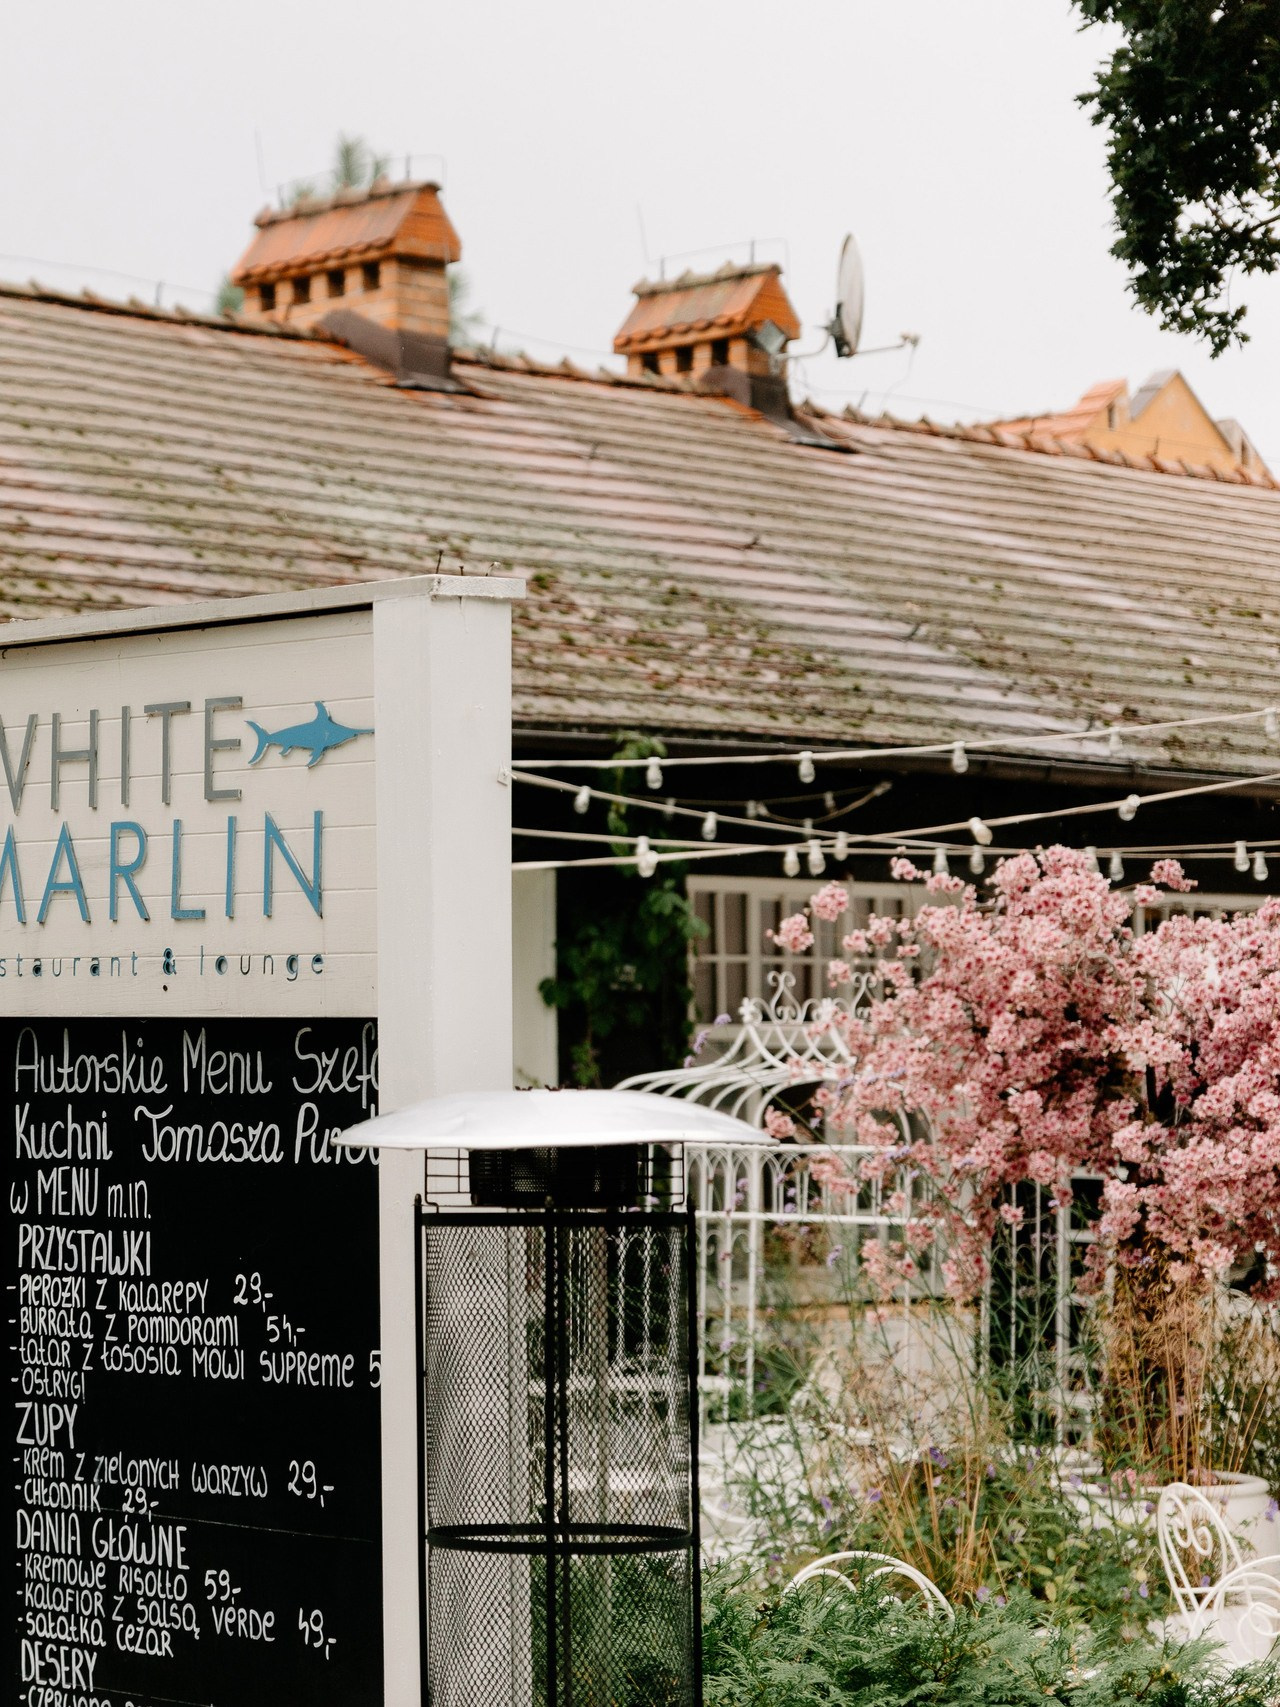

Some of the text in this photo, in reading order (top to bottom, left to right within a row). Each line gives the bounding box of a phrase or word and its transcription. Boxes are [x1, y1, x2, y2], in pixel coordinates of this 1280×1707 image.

[162, 947, 178, 977] &
[199, 945, 325, 982] lounge
[15, 1027, 168, 1094] Autorskie
[182, 1027, 273, 1095] Menu
[15, 1102, 114, 1161] Kuchni
[133, 1104, 285, 1164] Tomasza
[37, 1165, 99, 1217] MENU
[18, 1223, 151, 1277] PRZYSTAWKI
[14, 1401, 78, 1450] ZUPY
[16, 1508, 190, 1570] DANIA GŁÓWNE
[21, 1638, 98, 1693] DESERY
